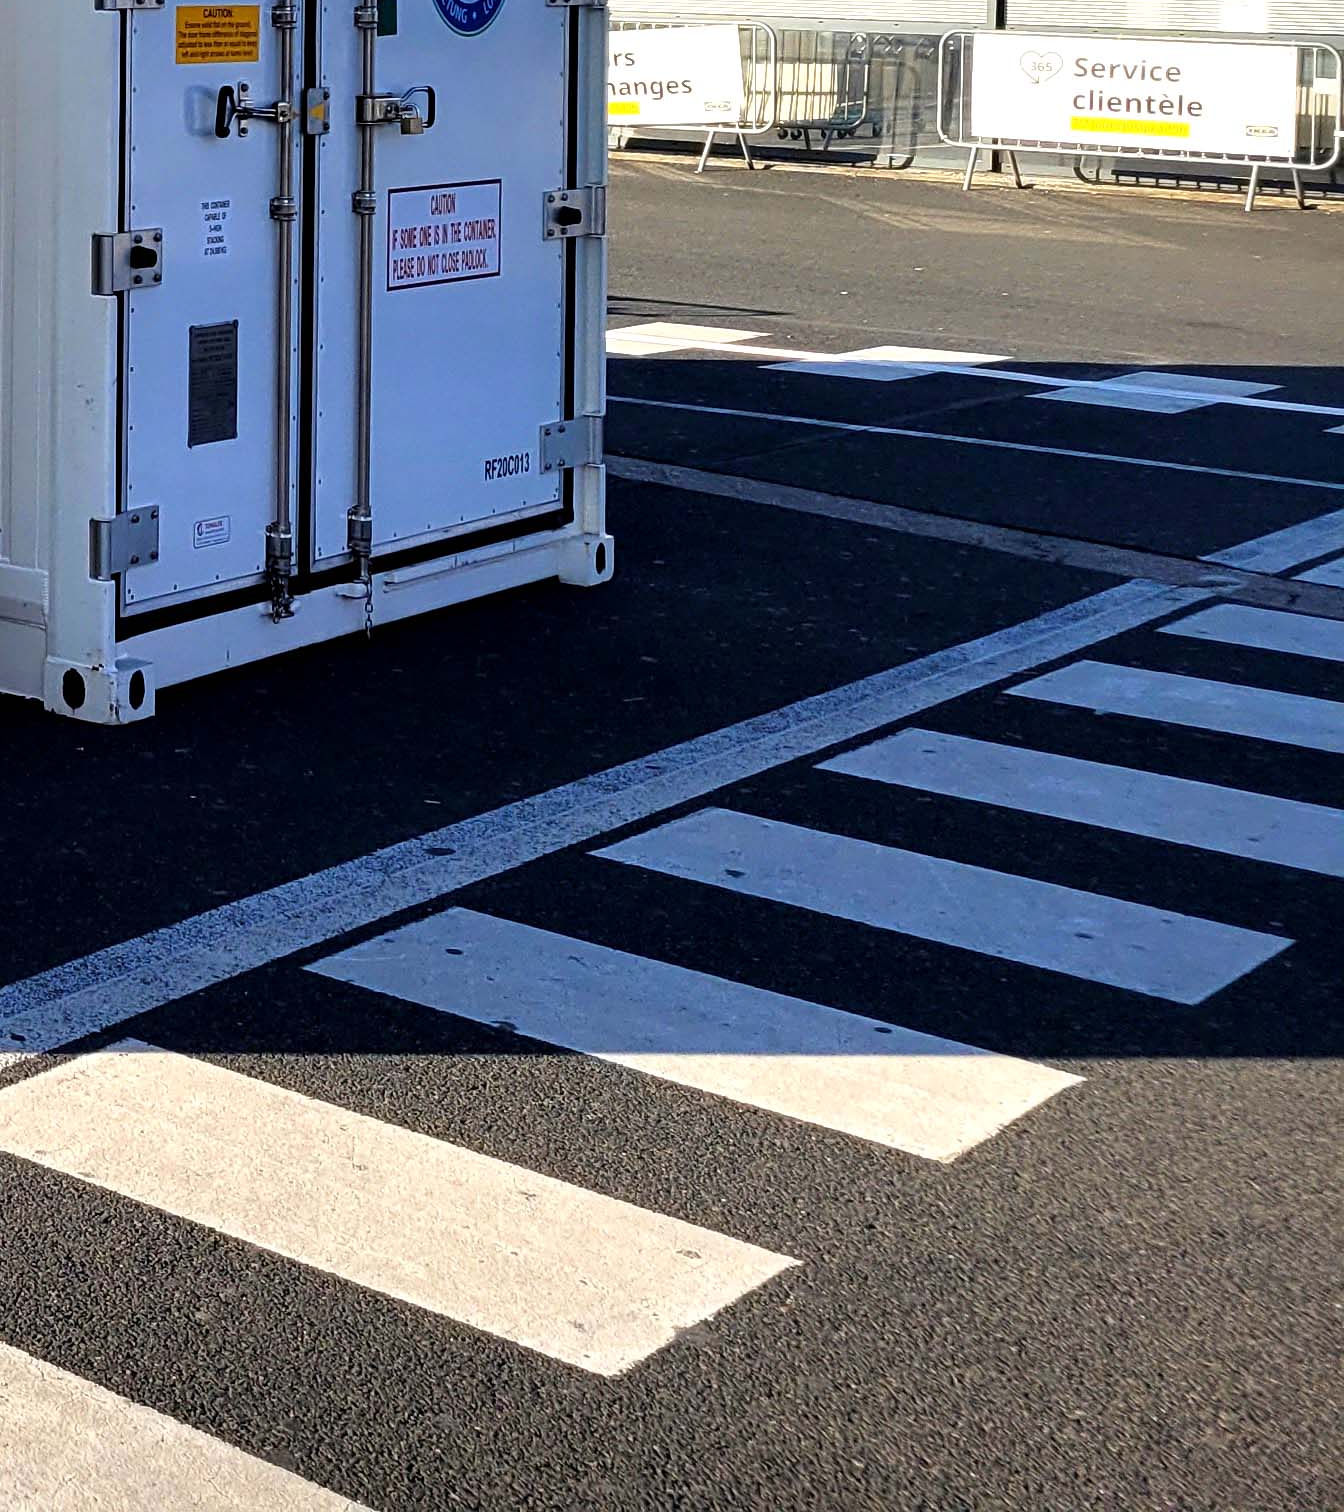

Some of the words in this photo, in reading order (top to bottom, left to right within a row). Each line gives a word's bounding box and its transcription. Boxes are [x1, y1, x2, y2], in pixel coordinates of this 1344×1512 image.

[608, 52, 636, 67] rs
[1073, 57, 1181, 82] Service
[1072, 89, 1203, 117] clientèle
[430, 193, 456, 215] CAUTION
[392, 229, 398, 251] IF
[401, 227, 417, 249] SOME
[419, 225, 431, 246] ONE
[434, 224, 440, 245] IS
[451, 222, 462, 243] THE
[393, 257, 414, 280] PLEASE
[417, 255, 425, 277] DO
[428, 254, 440, 276] NOT
[441, 251, 460, 273] CLOSE
[484, 452, 530, 480] RF20C013
